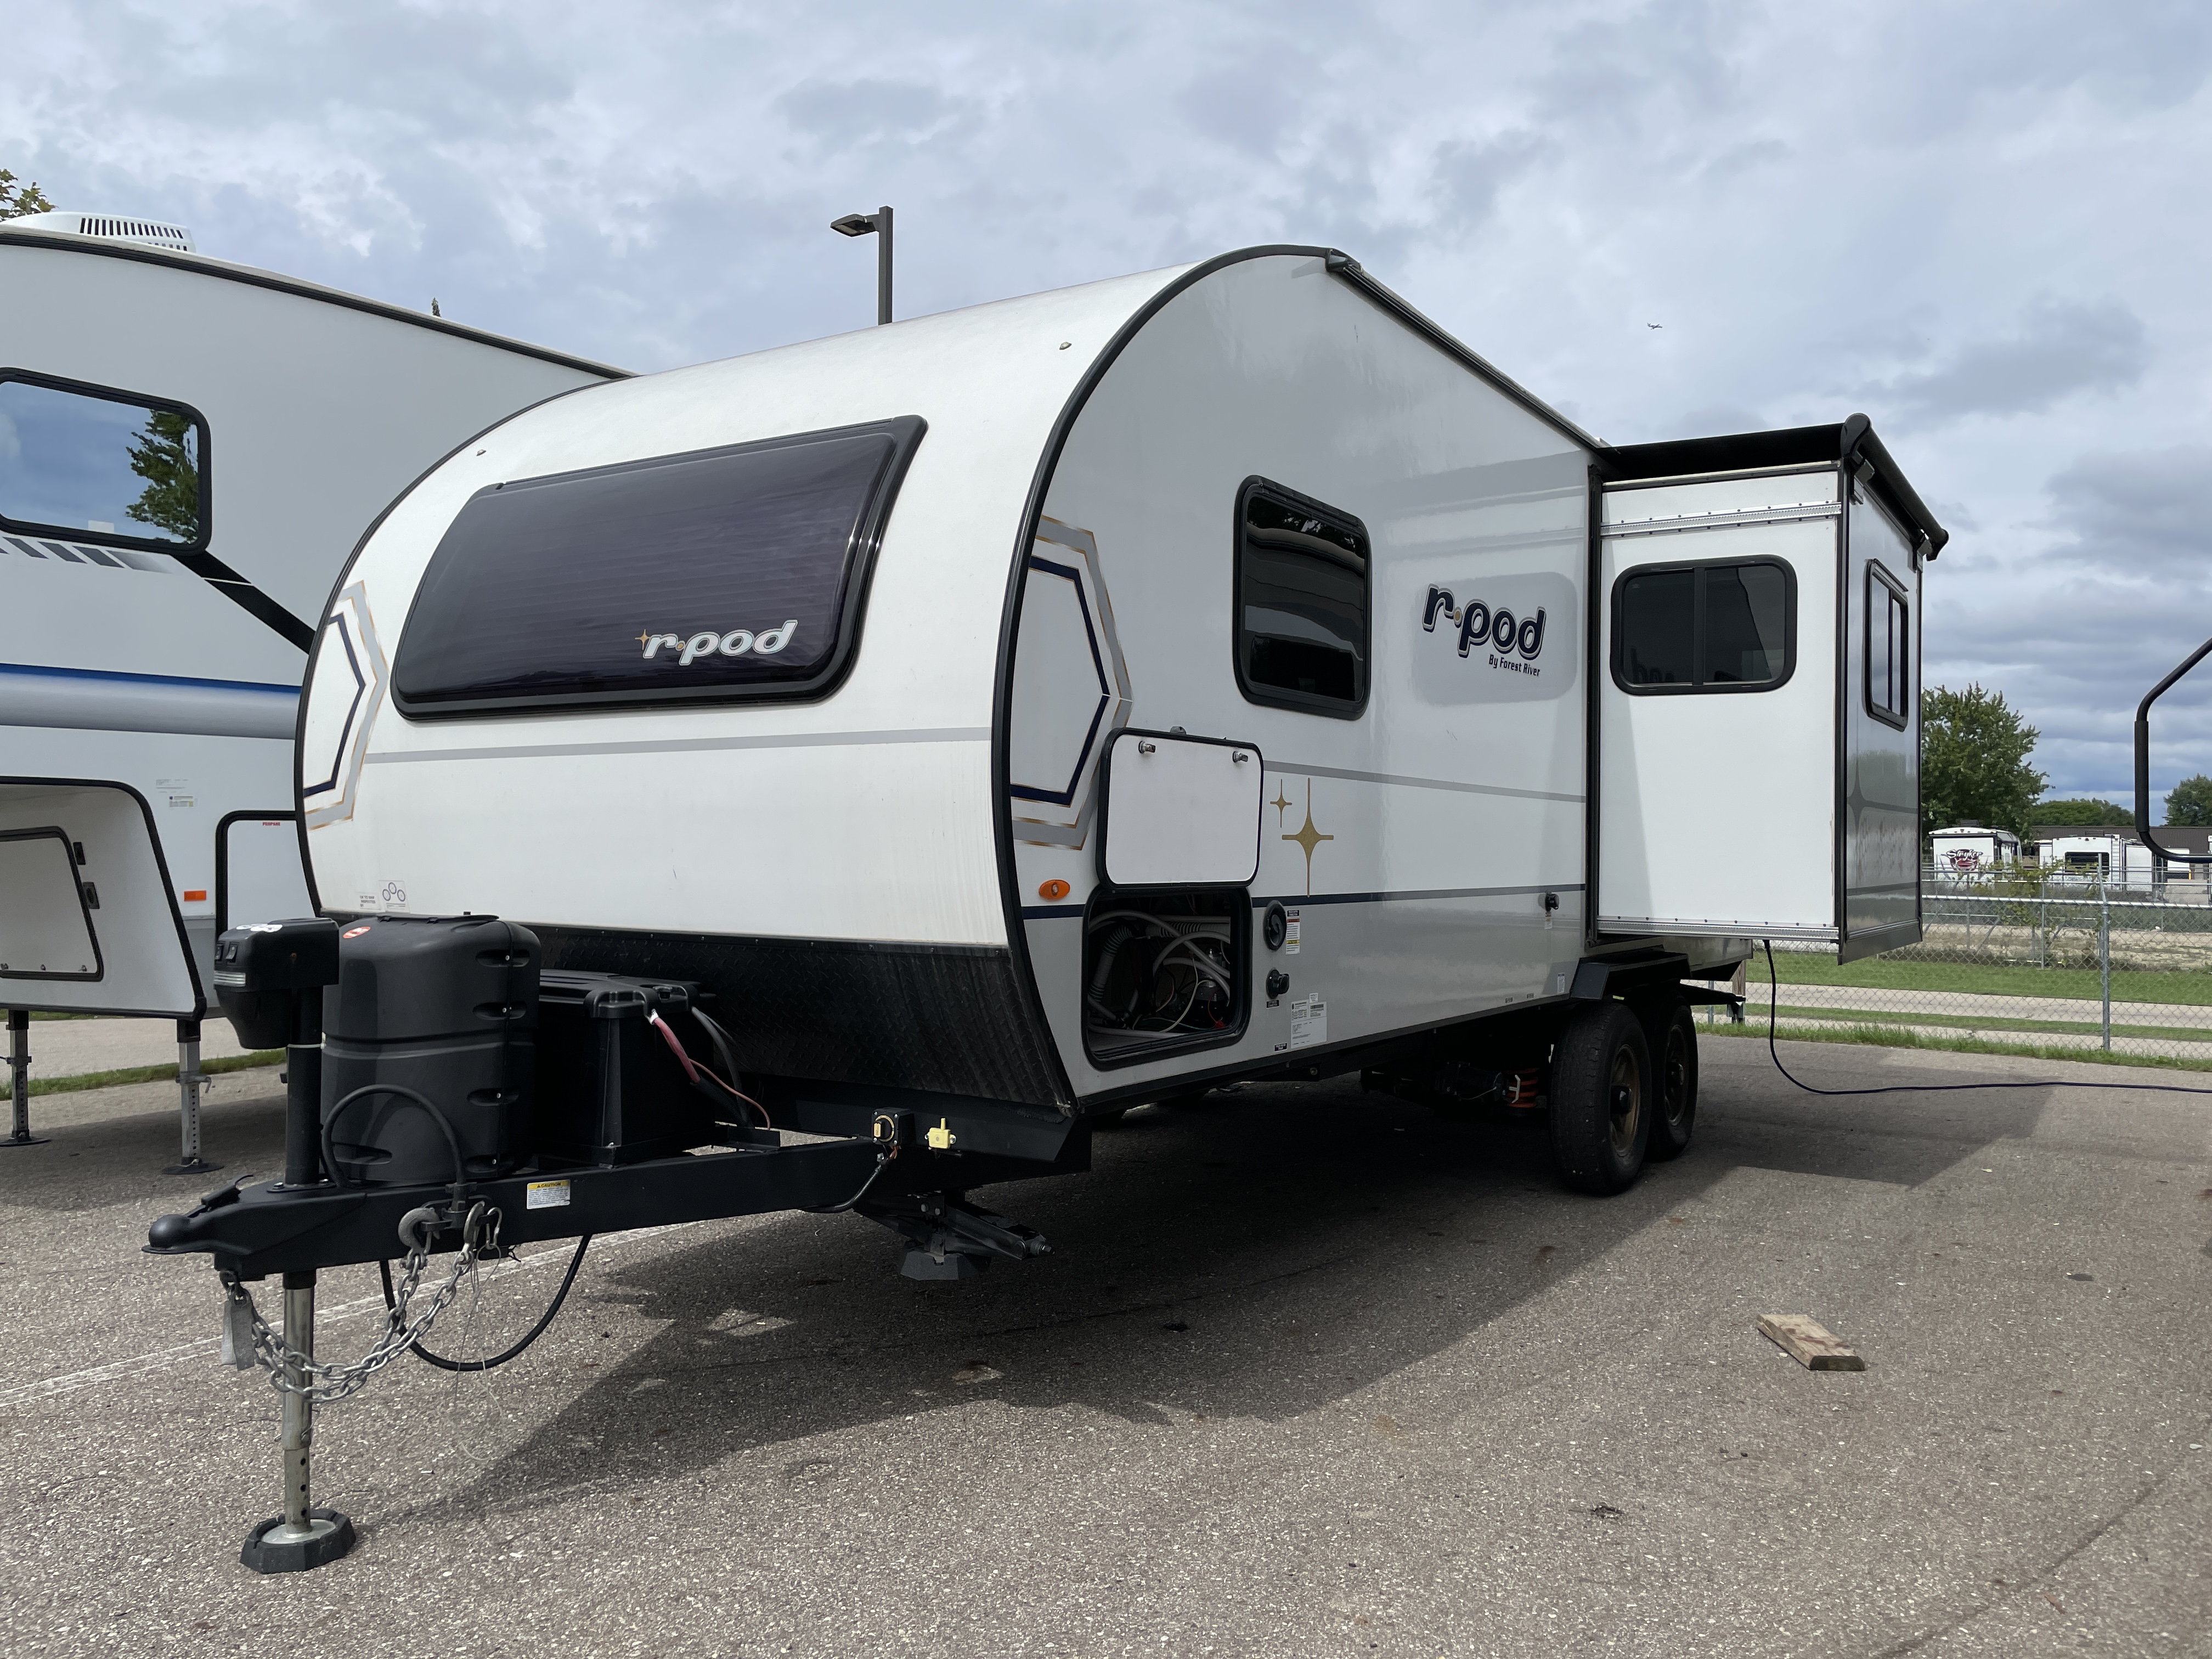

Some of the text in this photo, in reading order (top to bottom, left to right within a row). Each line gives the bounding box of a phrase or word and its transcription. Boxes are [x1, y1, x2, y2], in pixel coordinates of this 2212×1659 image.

[1488, 654, 1541, 676] By Forest River
[1943, 849, 1983, 861] Stryker
